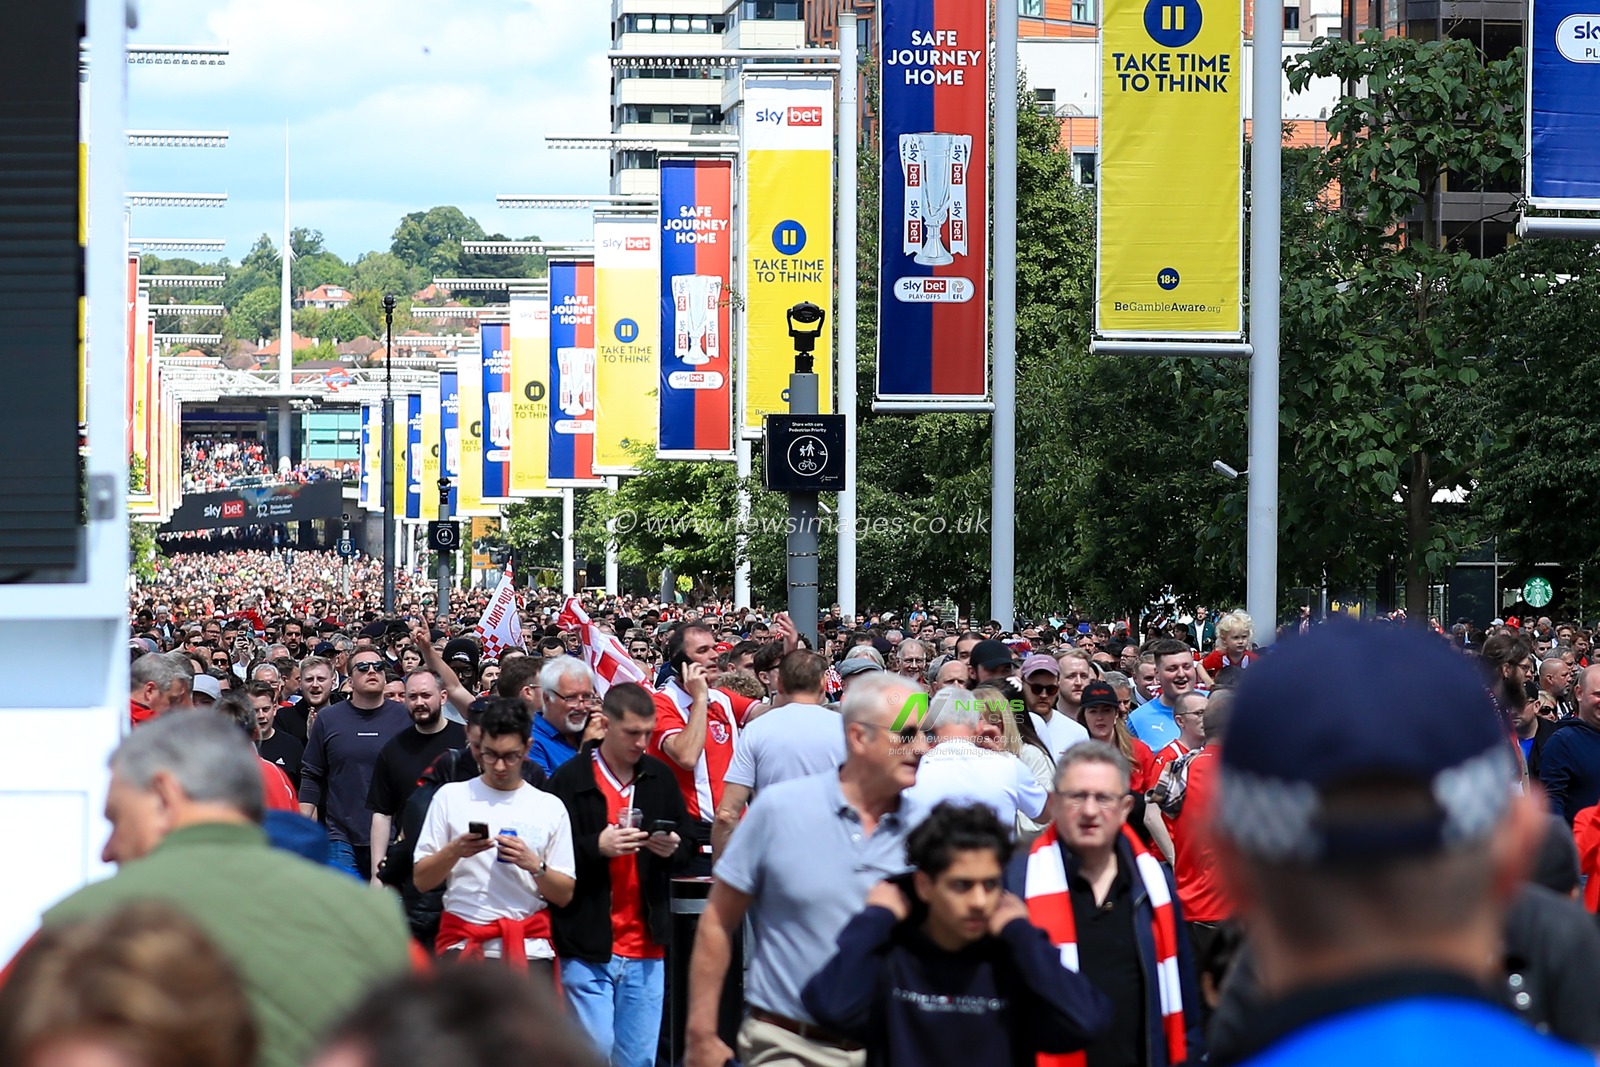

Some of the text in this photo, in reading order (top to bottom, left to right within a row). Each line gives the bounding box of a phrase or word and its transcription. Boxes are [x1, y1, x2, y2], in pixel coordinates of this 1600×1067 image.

[1574, 21, 1600, 39] sk
[911, 30, 957, 46] SAFE
[887, 49, 981, 66] JOURNEY
[1112, 53, 1230, 72] TAKE TIME
[905, 69, 964, 85] HOME
[1118, 74, 1228, 92] TO THINK
[756, 108, 820, 125] sky bet
[908, 143, 920, 185] sky bet
[952, 144, 963, 184] sky bet
[679, 206, 712, 217] SAFE
[663, 219, 729, 231] JOURNEY
[909, 200, 920, 241] sky bet
[952, 201, 963, 240] sky bet
[602, 238, 649, 249] sky bet
[675, 232, 716, 244] HOME
[753, 259, 824, 270] TAKE TIME
[757, 272, 822, 283] TO THINK
[1160, 275, 1177, 284] 18+
[903, 281, 945, 293] sky bet
[563, 295, 589, 305] SAFE
[1114, 301, 1221, 313] BeGambleAware.org
[560, 315, 592, 325] HOME
[600, 346, 652, 354] TAKE TIME
[483, 358, 510, 367] JOURN
[603, 355, 650, 363] TO THINK
[489, 366, 510, 374] HOM
[514, 403, 534, 411] TAKE
[515, 411, 548, 419] TO THIN
[203, 502, 242, 518] sky bet
